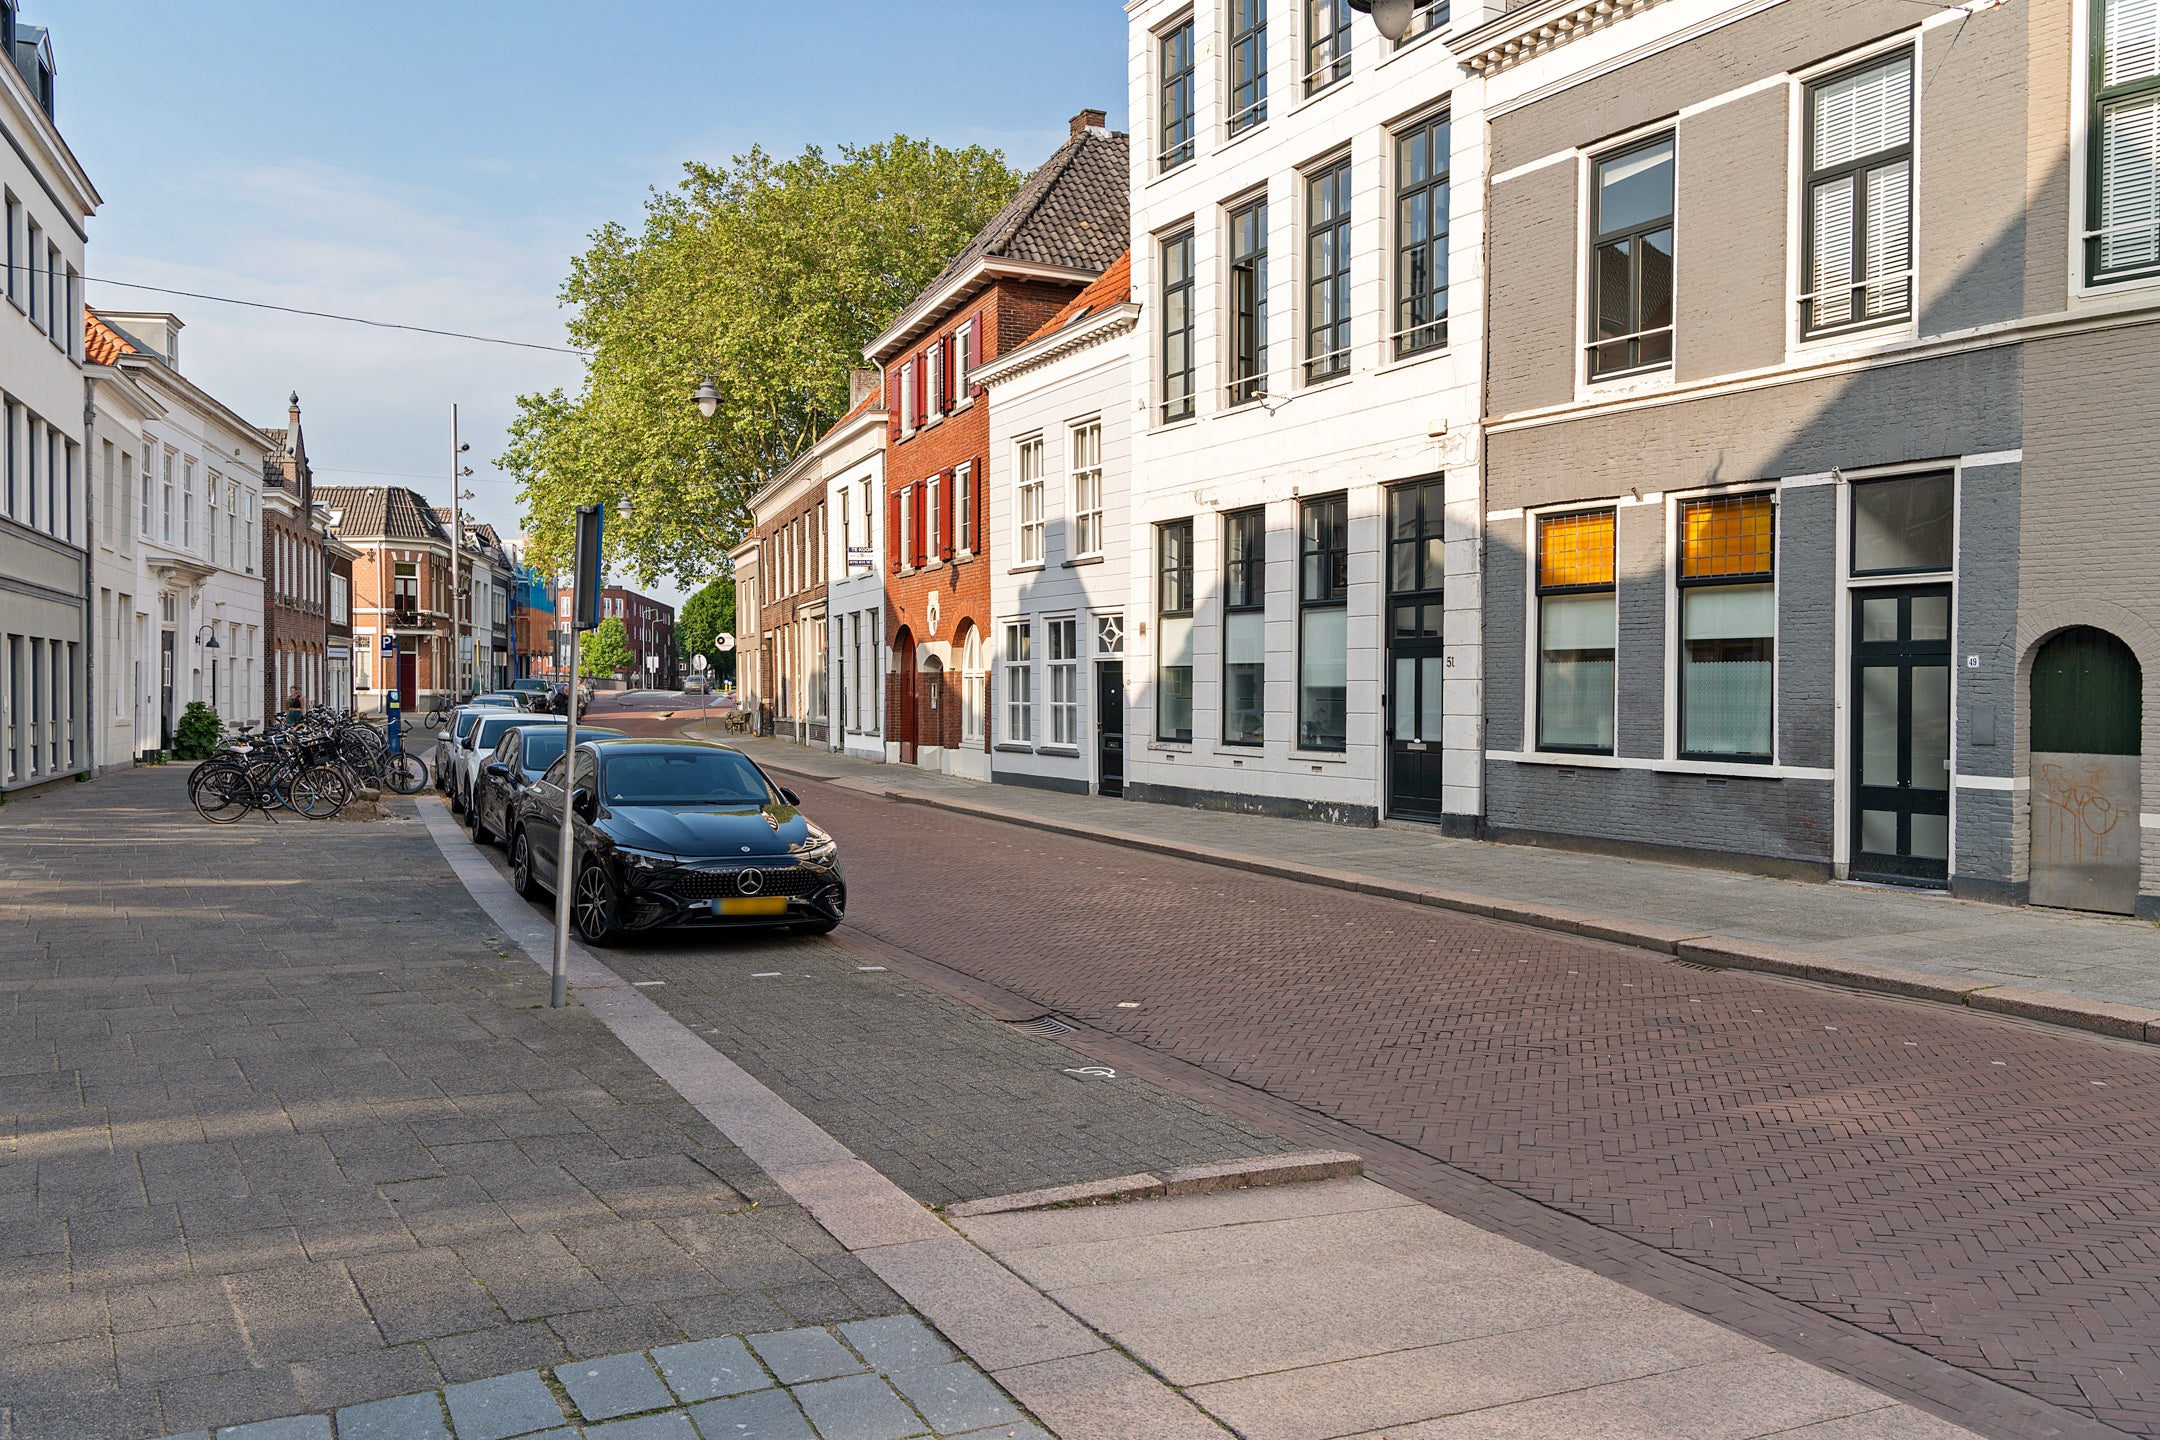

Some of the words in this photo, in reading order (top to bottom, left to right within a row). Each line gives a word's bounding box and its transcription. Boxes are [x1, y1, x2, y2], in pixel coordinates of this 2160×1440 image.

[383, 636, 391, 648] P
[1446, 656, 1455, 668] 51
[1969, 657, 1977, 666] 49
